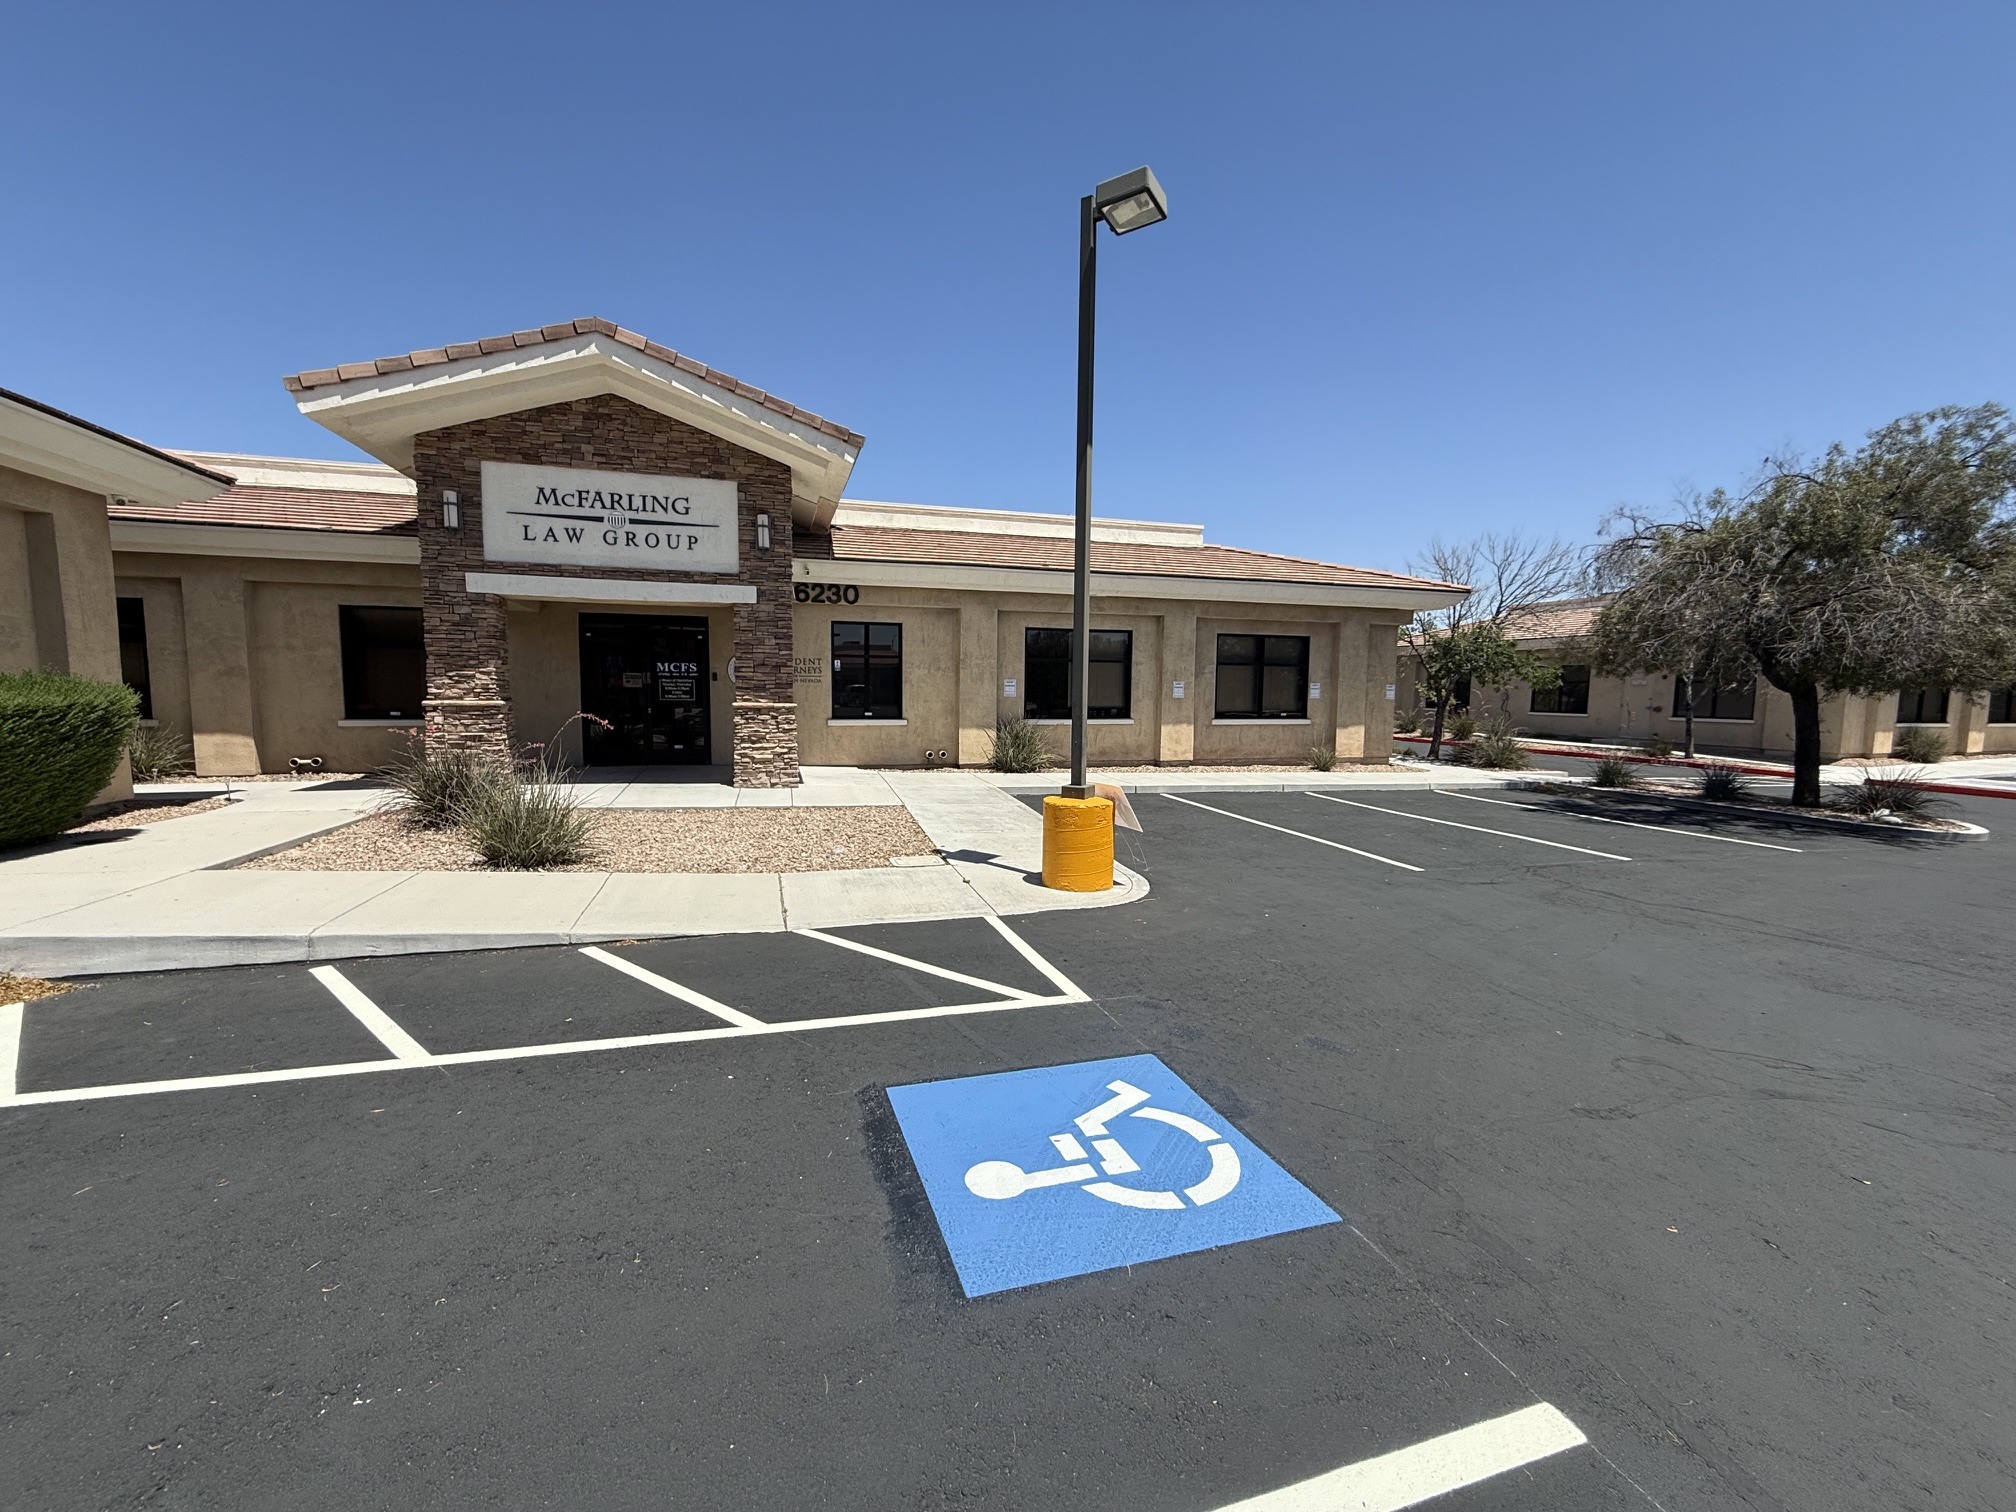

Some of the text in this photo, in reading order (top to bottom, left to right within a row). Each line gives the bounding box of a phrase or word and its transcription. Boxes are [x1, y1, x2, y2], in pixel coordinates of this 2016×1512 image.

[535, 486, 691, 515] McFARLING
[522, 524, 700, 551] LAW GROUP
[794, 582, 860, 605] 6230
[656, 662, 697, 671] MCFS
[794, 657, 823, 666] DENT
[793, 666, 823, 675] RNEYS
